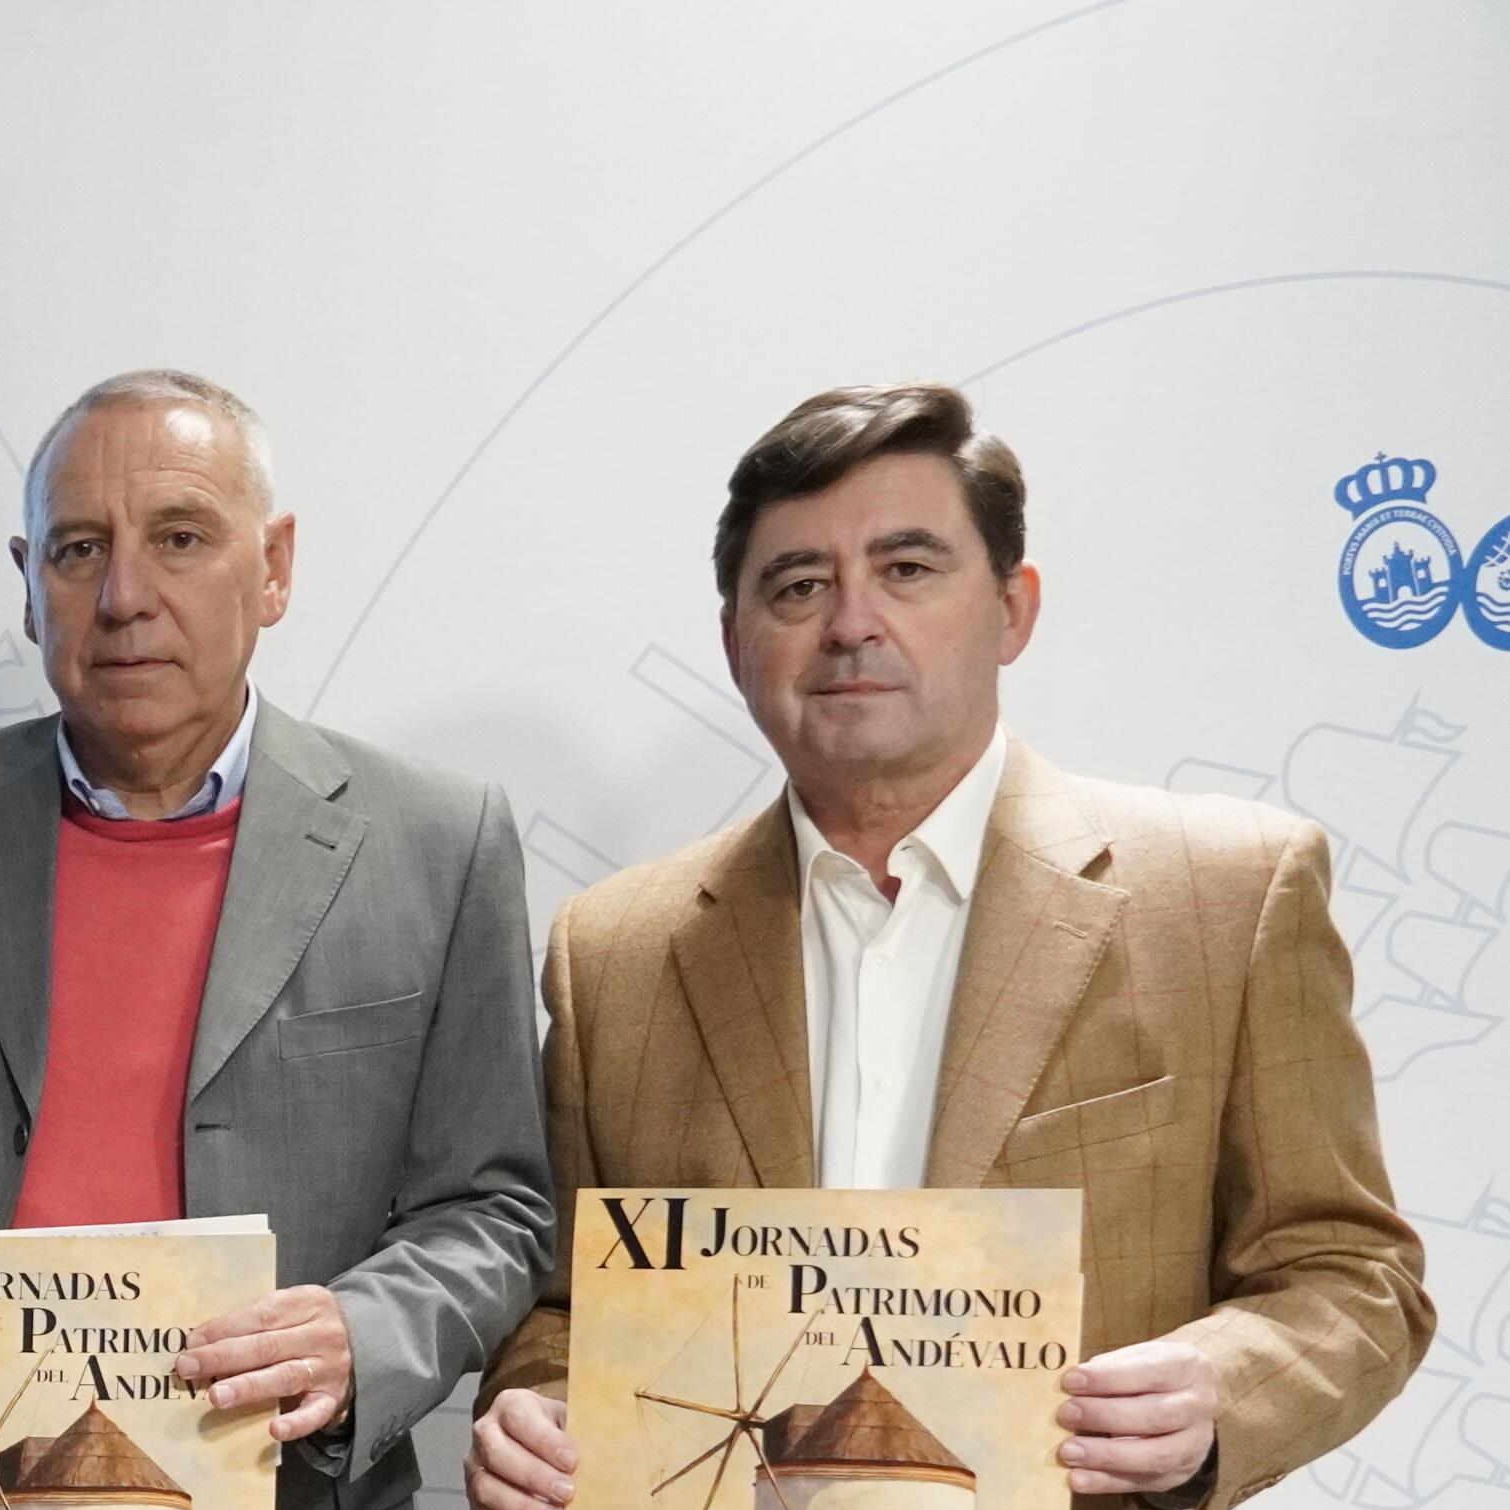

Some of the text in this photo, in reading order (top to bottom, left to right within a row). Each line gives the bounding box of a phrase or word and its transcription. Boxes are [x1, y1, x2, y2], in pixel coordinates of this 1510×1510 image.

[596, 1197, 689, 1270] XI
[747, 1274, 770, 1289] DE
[20, 1307, 194, 1354] PATRIMO
[805, 1330, 840, 1346] DEL
[37, 1370, 68, 1383] DEL
